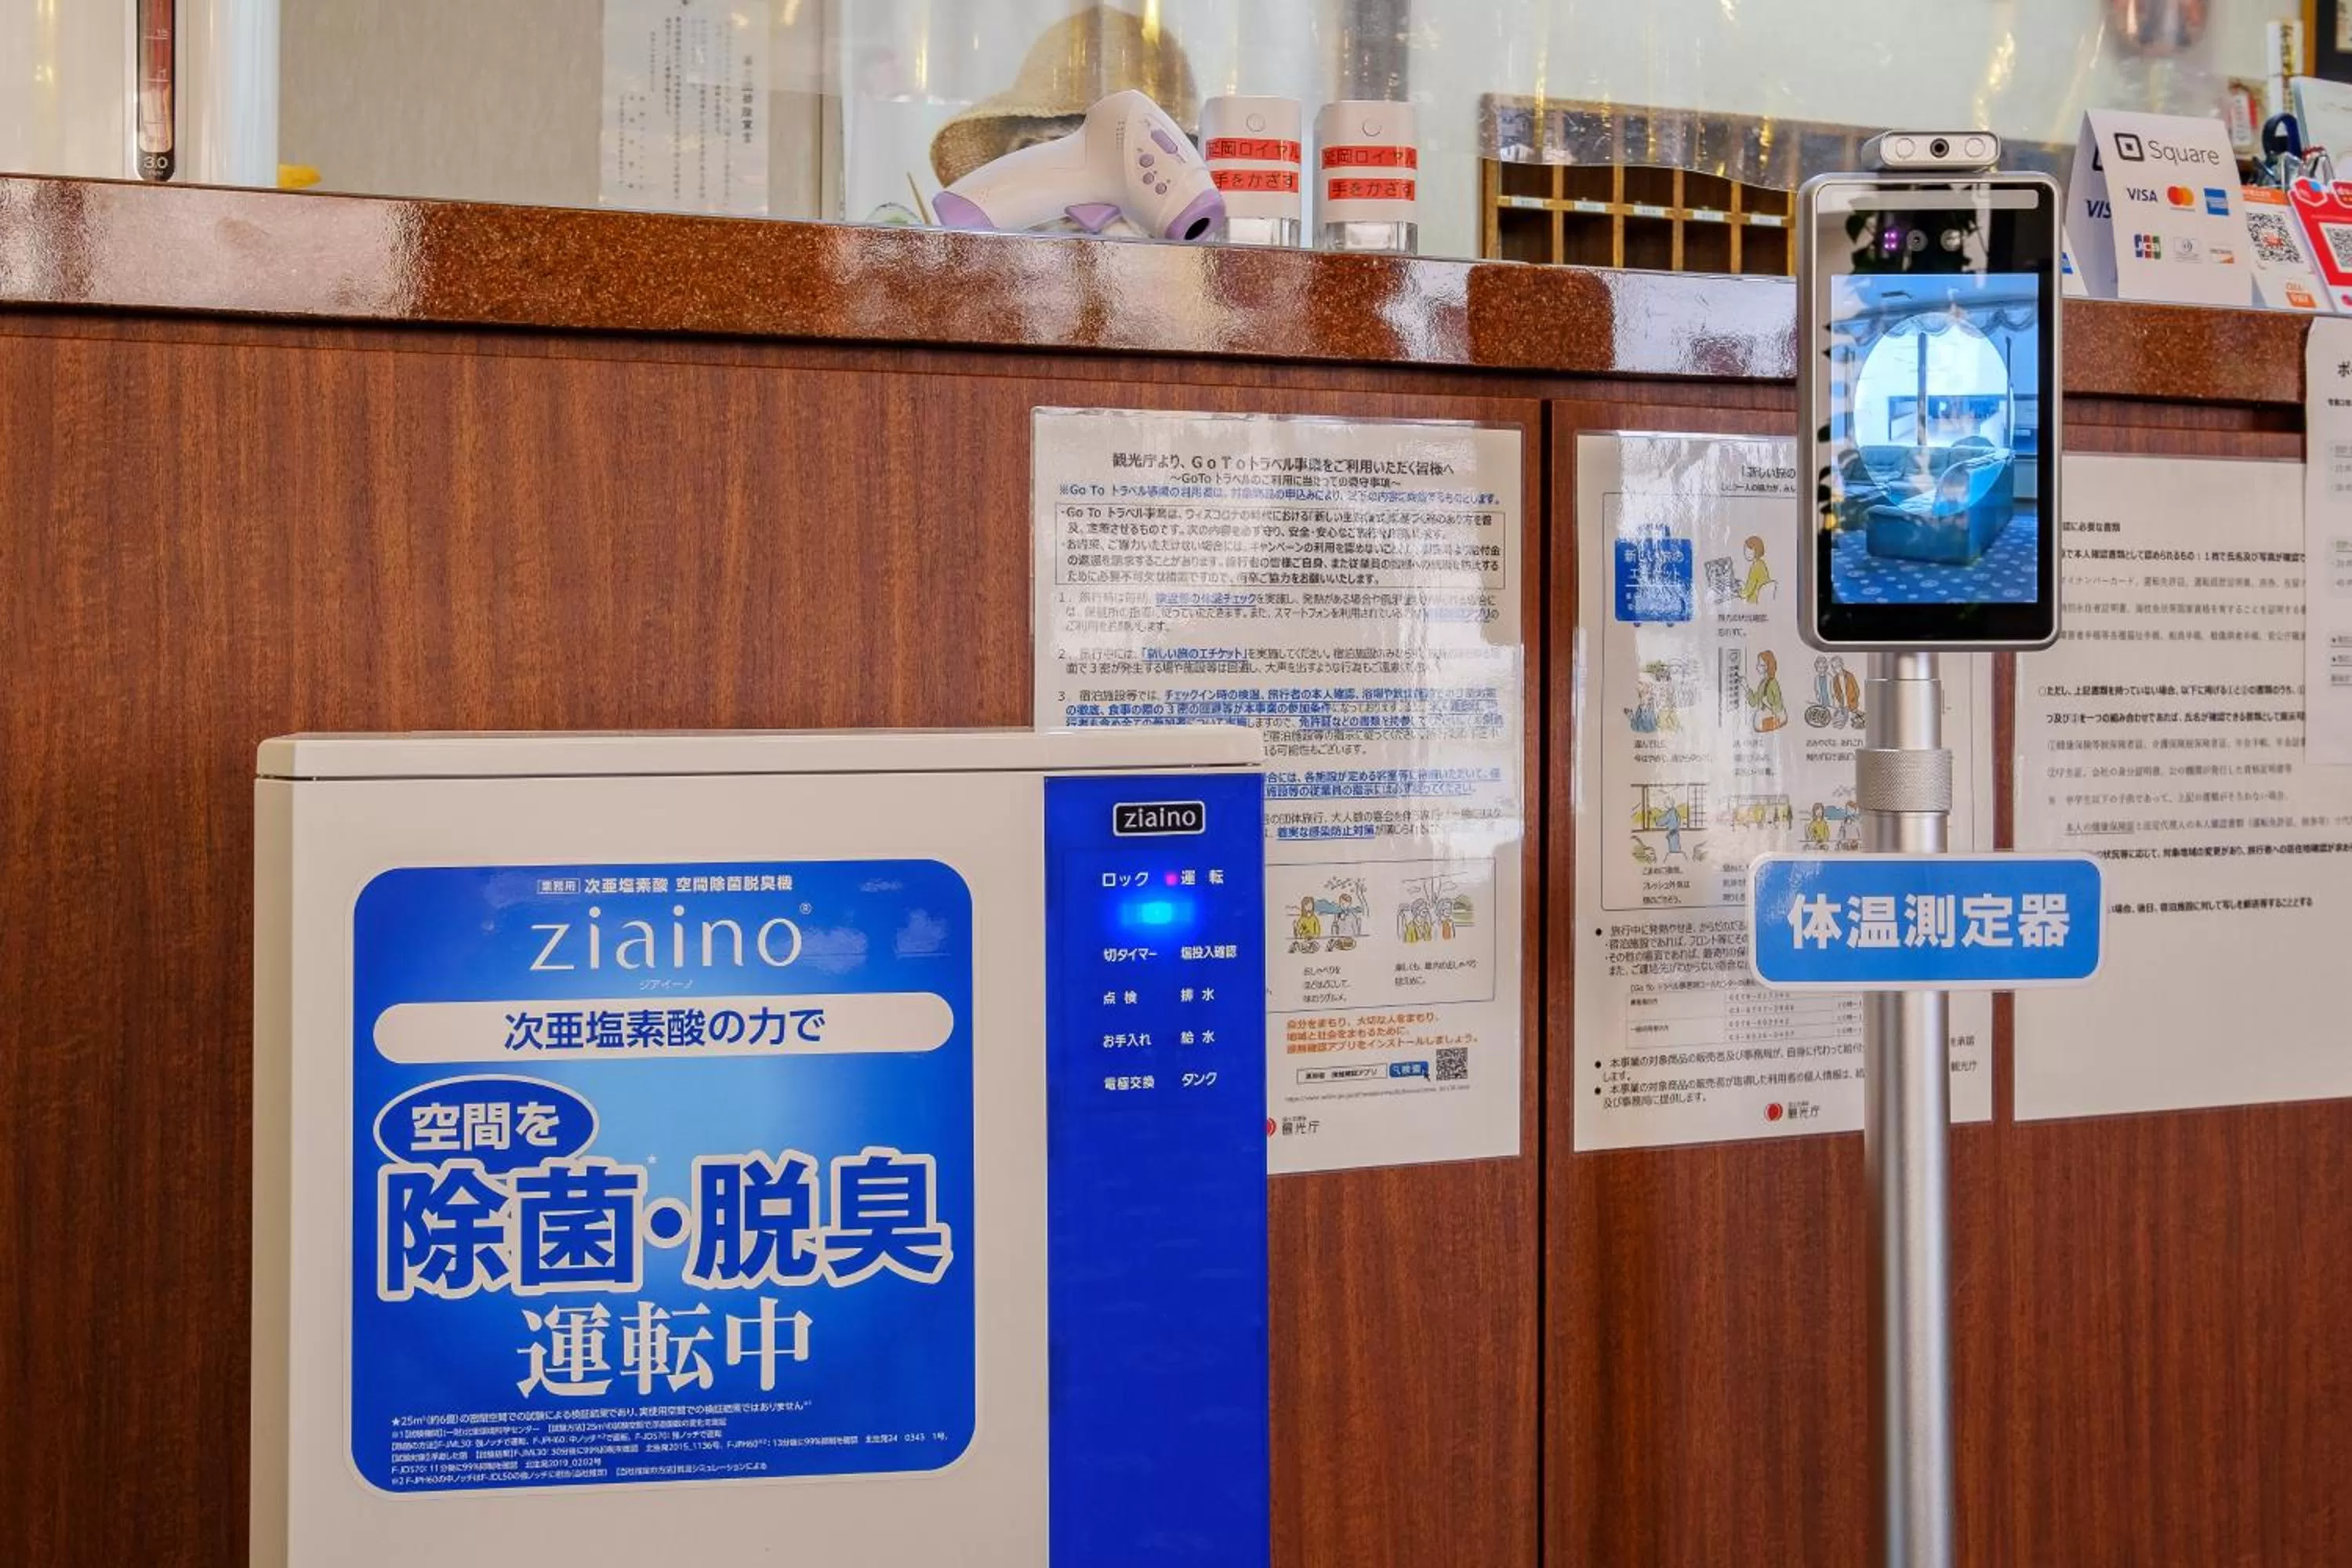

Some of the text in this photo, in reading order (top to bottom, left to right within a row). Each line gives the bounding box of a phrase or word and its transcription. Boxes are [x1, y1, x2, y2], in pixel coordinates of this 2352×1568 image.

[2148, 140, 2220, 165] Square
[2126, 187, 2158, 202] VISA
[2085, 200, 2111, 219] VIS
[1123, 808, 1197, 829] ziaino
[584, 877, 668, 893] 次亜塩素酸
[676, 874, 793, 891] 空間除菌脱臭機
[1102, 872, 1149, 887] ロック
[1787, 893, 2071, 949] 体温測定器
[529, 905, 802, 971] ziaino
[1104, 946, 1237, 962] 切タイマー 塩投入確認
[640, 978, 694, 990] ジアイーノ
[503, 1007, 826, 1051] 次亜塩素酸の力で
[1103, 1034, 1152, 1047] お手入れ
[1104, 1072, 1218, 1091] 電極交換 タンク
[410, 1101, 560, 1151] 空間を
[379, 1149, 951, 1299] 除菌・脱臭
[516, 1298, 814, 1399] 運転中
